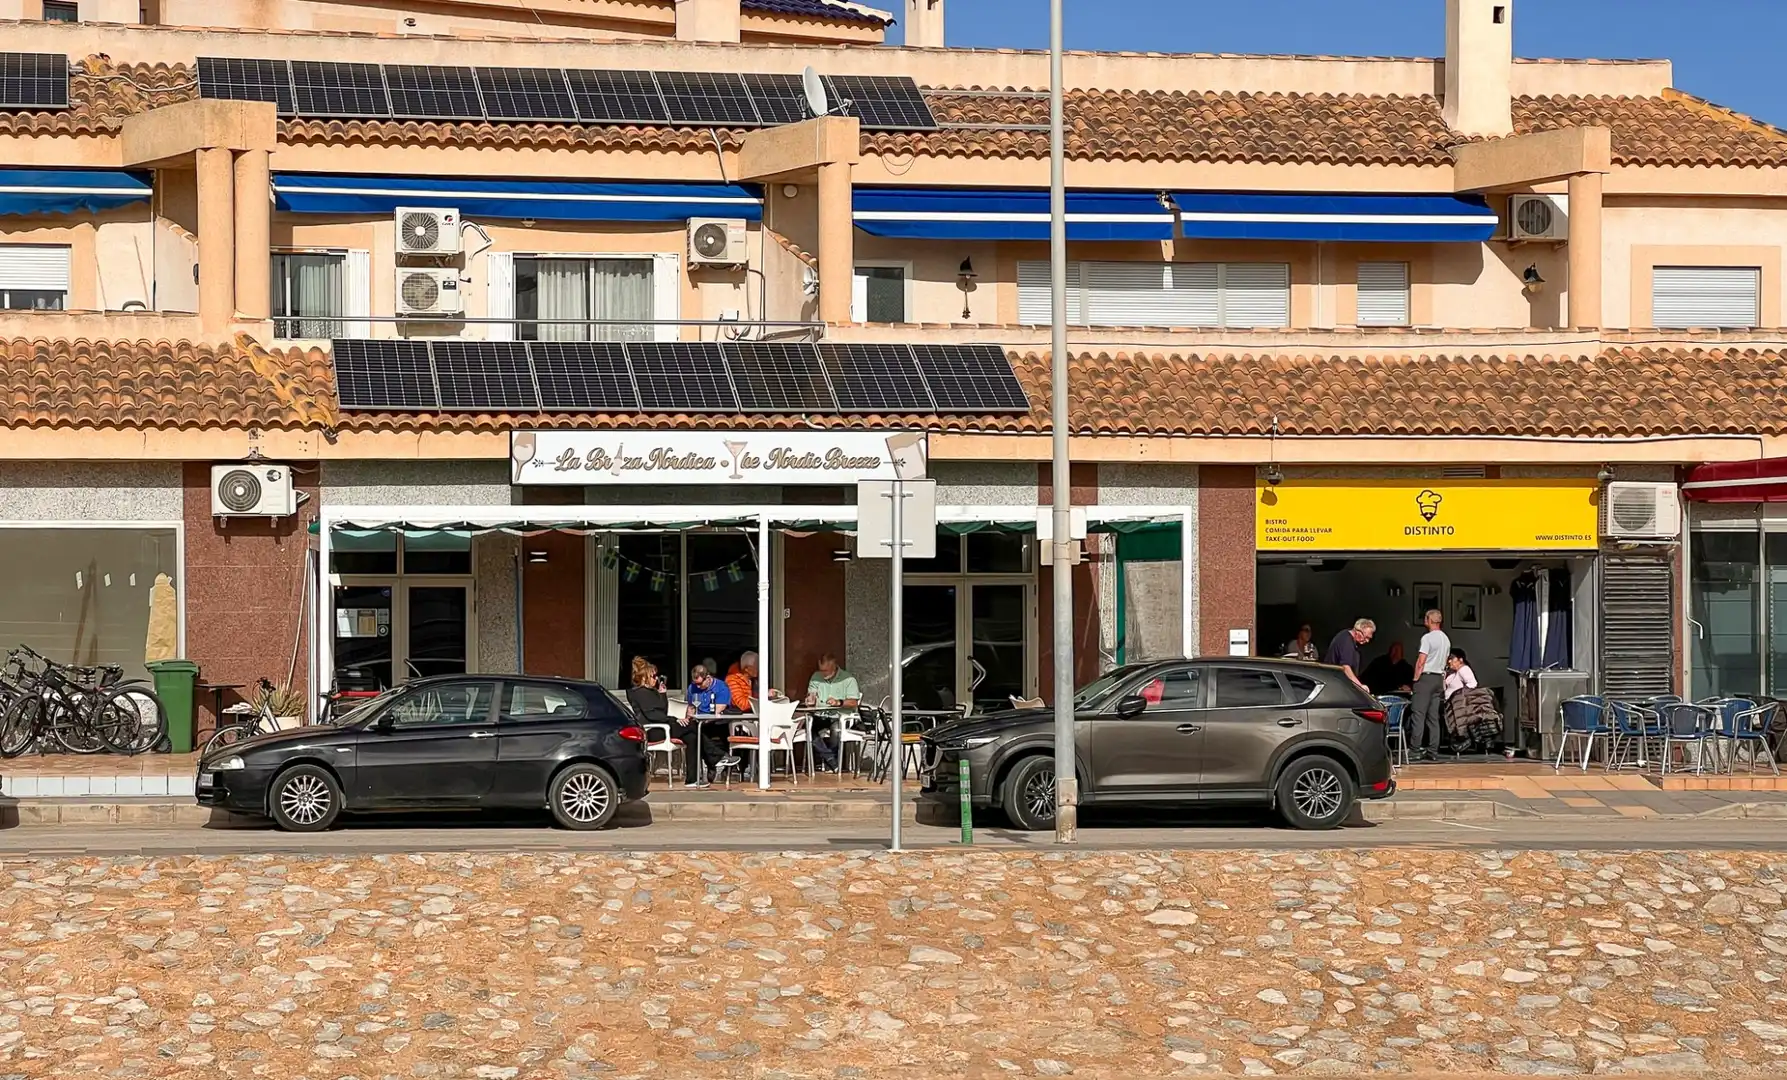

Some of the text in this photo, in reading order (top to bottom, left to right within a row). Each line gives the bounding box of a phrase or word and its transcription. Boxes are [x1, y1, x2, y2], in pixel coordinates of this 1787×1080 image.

[554, 447, 582, 472] La
[643, 447, 717, 471] Nordica
[763, 447, 822, 471] Nordic
[822, 446, 881, 471] Breeze
[1404, 525, 1455, 536] DISTINTO
